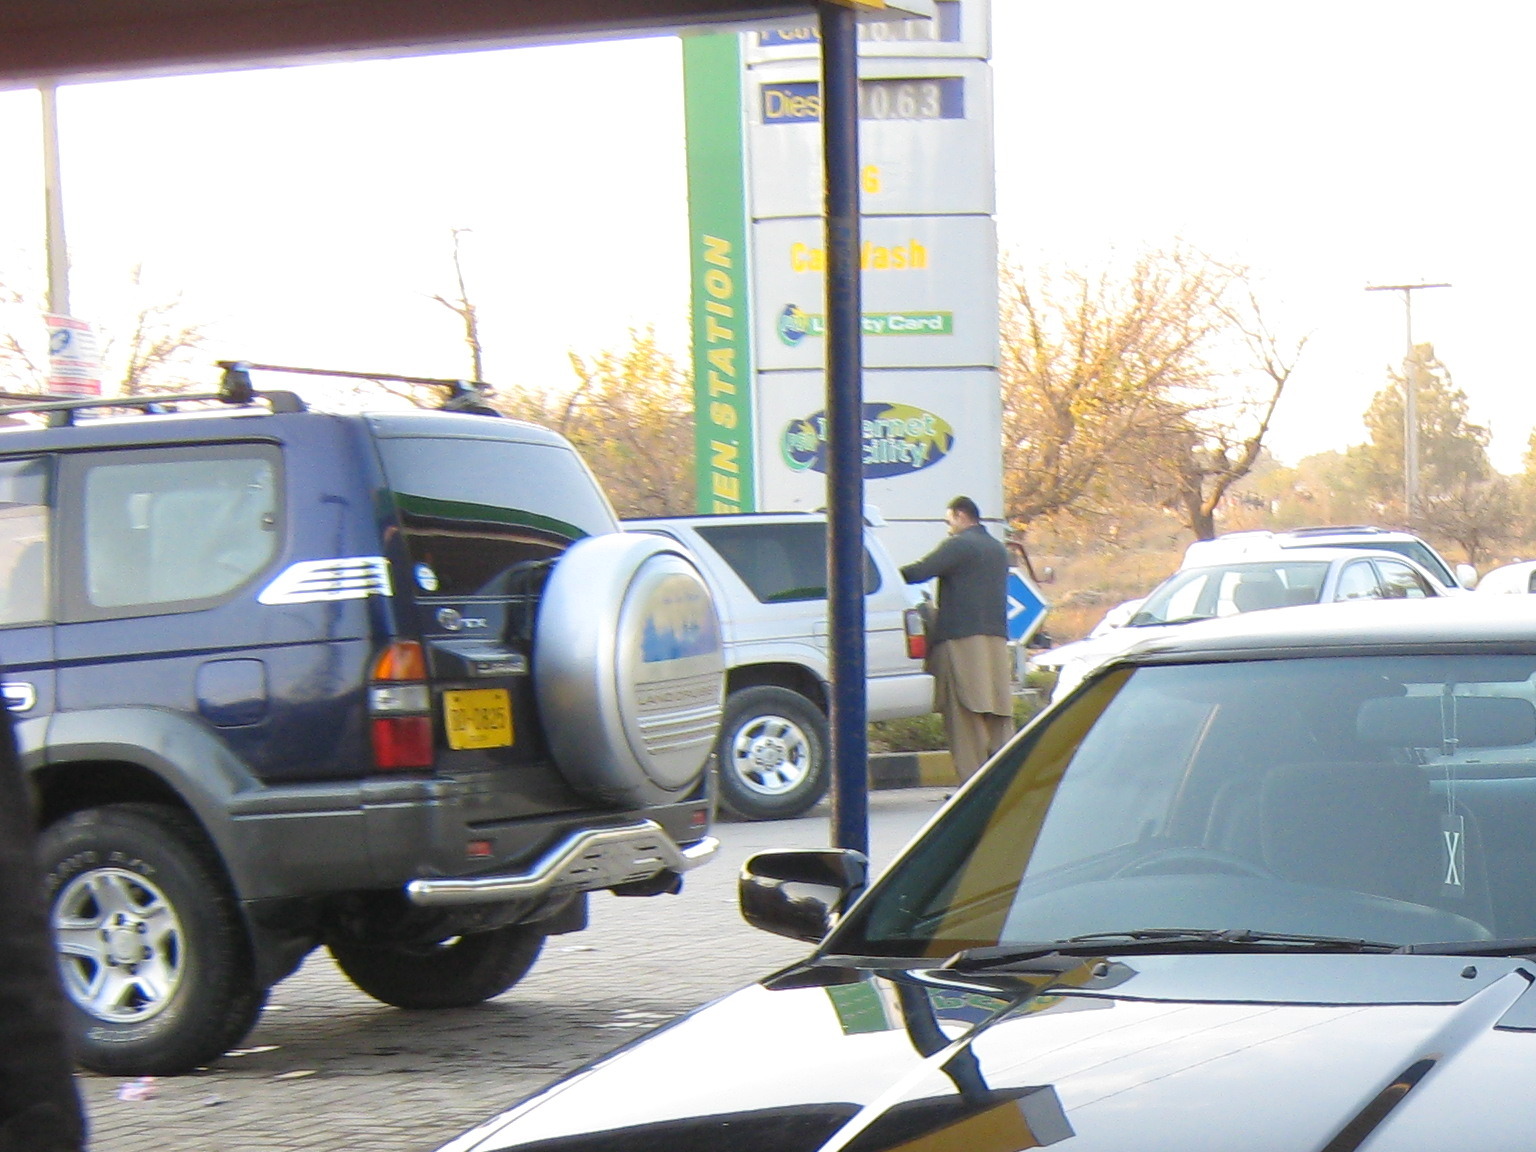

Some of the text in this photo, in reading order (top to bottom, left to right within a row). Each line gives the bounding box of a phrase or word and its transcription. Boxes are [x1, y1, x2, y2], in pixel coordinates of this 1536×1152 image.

[764, 89, 821, 119] Dies
[790, 242, 827, 271] Ca
[703, 234, 738, 429] STATION
[888, 315, 944, 331] Card
[817, 413, 936, 442] Iernet
